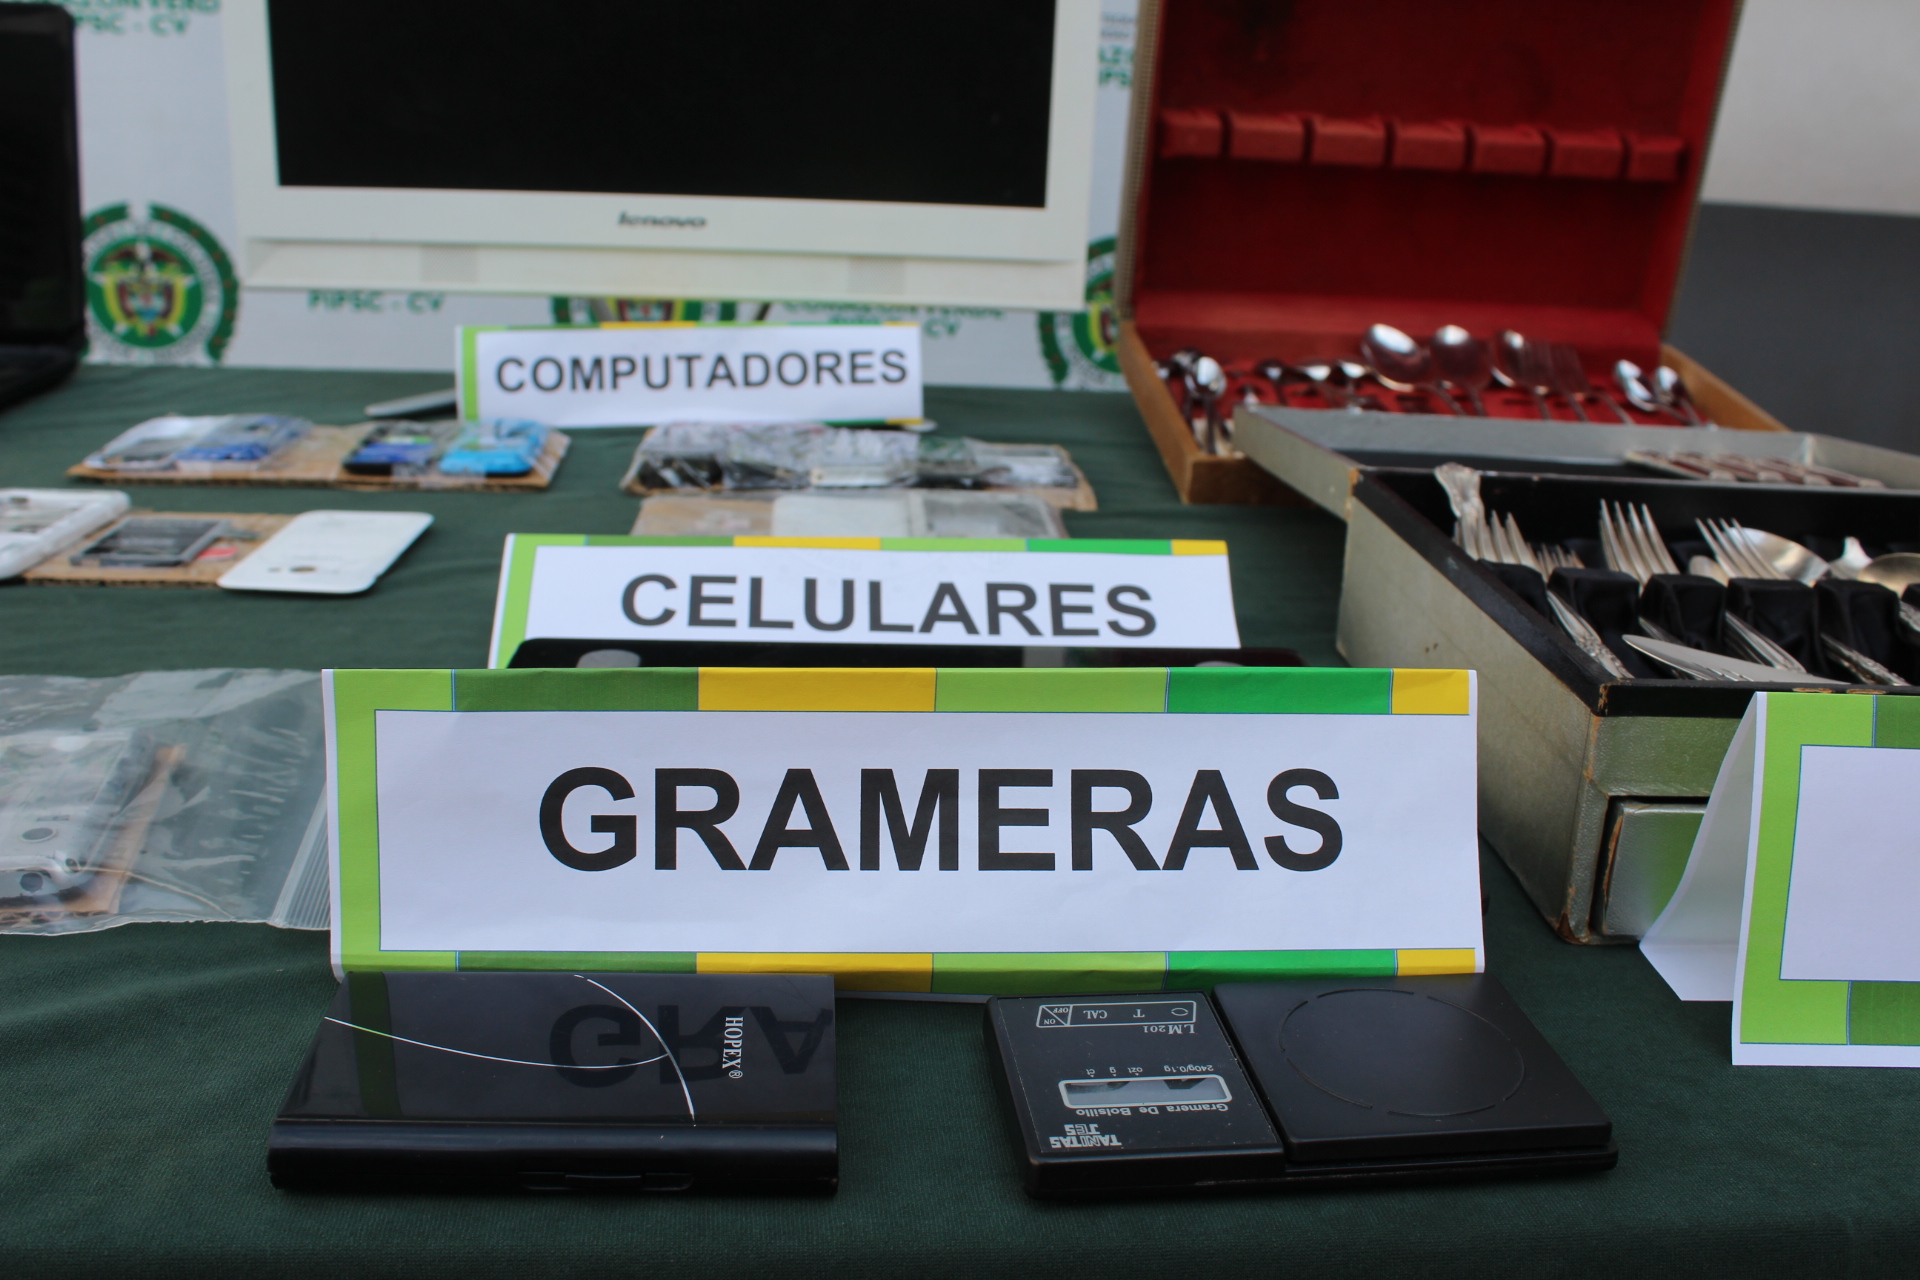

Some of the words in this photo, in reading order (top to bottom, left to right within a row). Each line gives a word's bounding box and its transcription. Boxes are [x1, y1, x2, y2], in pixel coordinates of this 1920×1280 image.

[496, 350, 908, 393] COMPUTADORES
[621, 573, 1158, 638] CELULARES
[539, 766, 1344, 873] GRAMERAS
[1083, 1009, 1108, 1019] CAL
[1133, 1008, 1145, 1018] T
[1076, 1108, 1132, 1116] Bolsillo
[1167, 1104, 1228, 1112] Gramera
